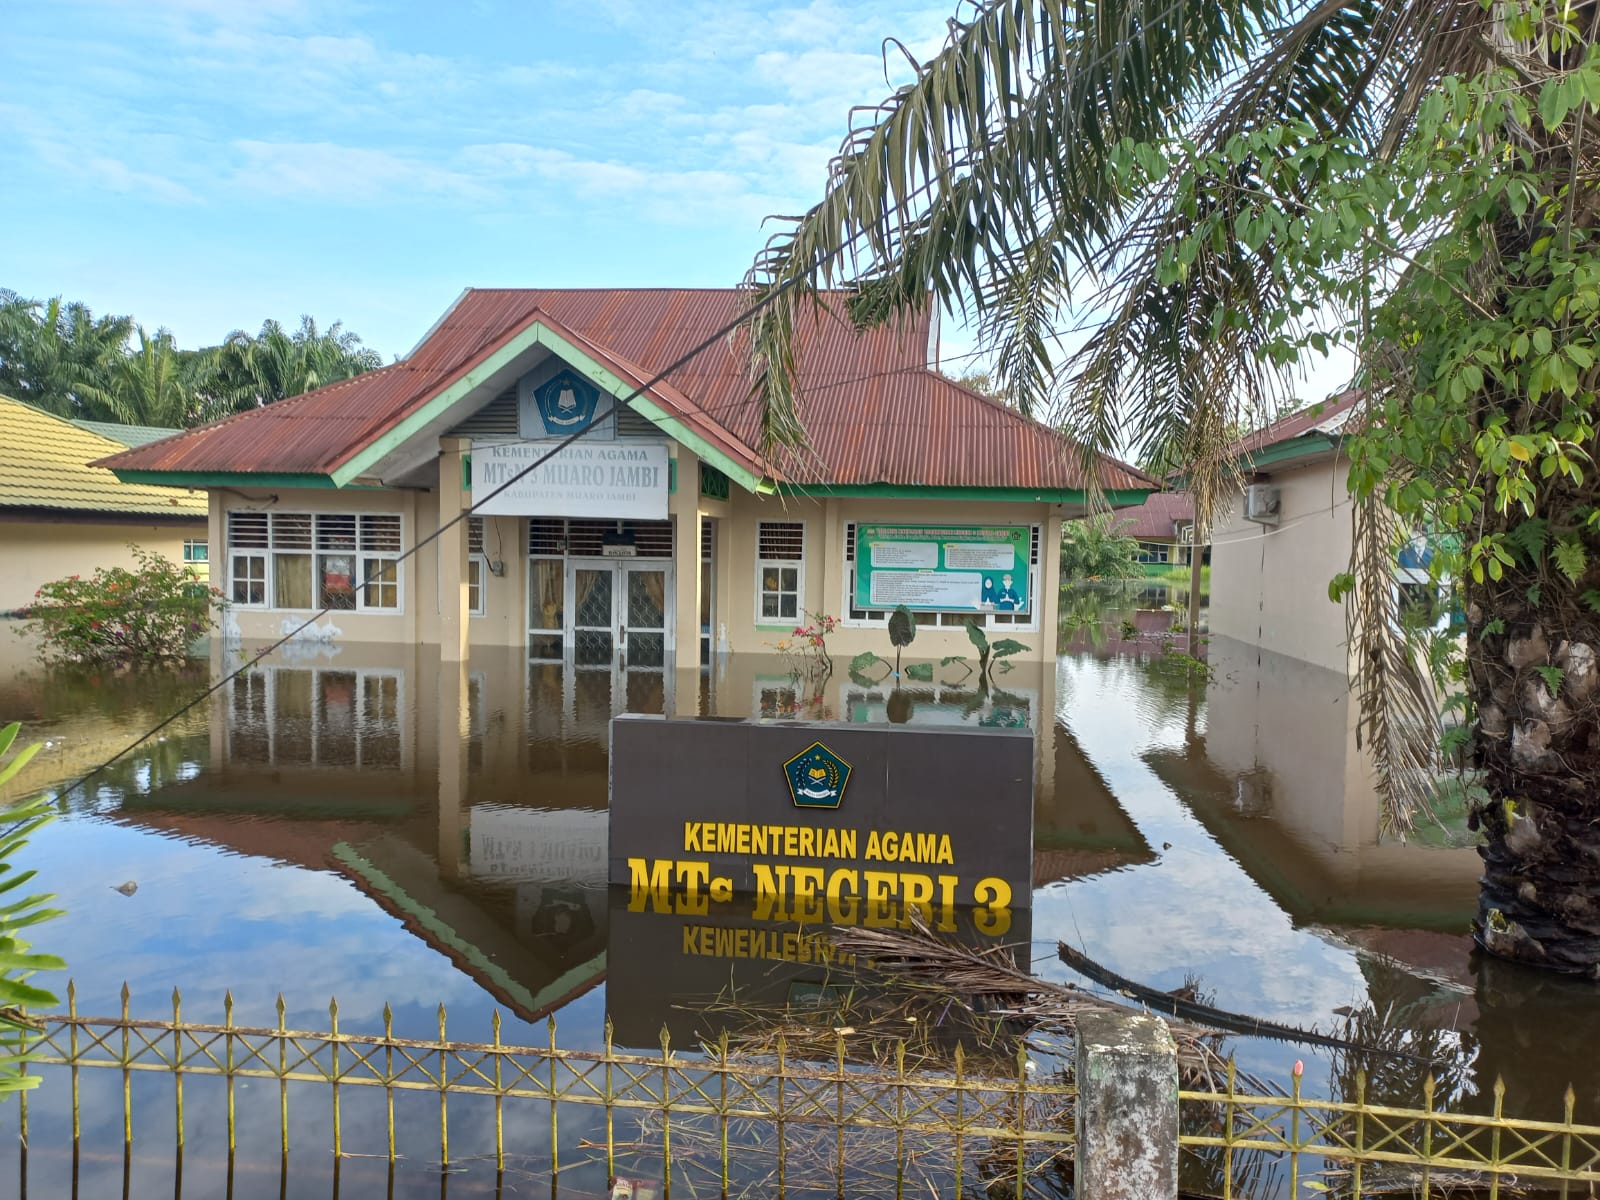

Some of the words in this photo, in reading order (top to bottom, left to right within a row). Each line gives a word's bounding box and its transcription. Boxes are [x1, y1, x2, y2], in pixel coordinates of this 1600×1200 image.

[598, 449, 648, 461] AGAMA
[543, 463, 604, 487] MUARO
[609, 465, 659, 488] JAMBI
[684, 822, 857, 860] KEMENTERIAN
[864, 830, 954, 865] AGAMA
[752, 863, 959, 906] NEGERI
[974, 876, 1012, 909] 3
